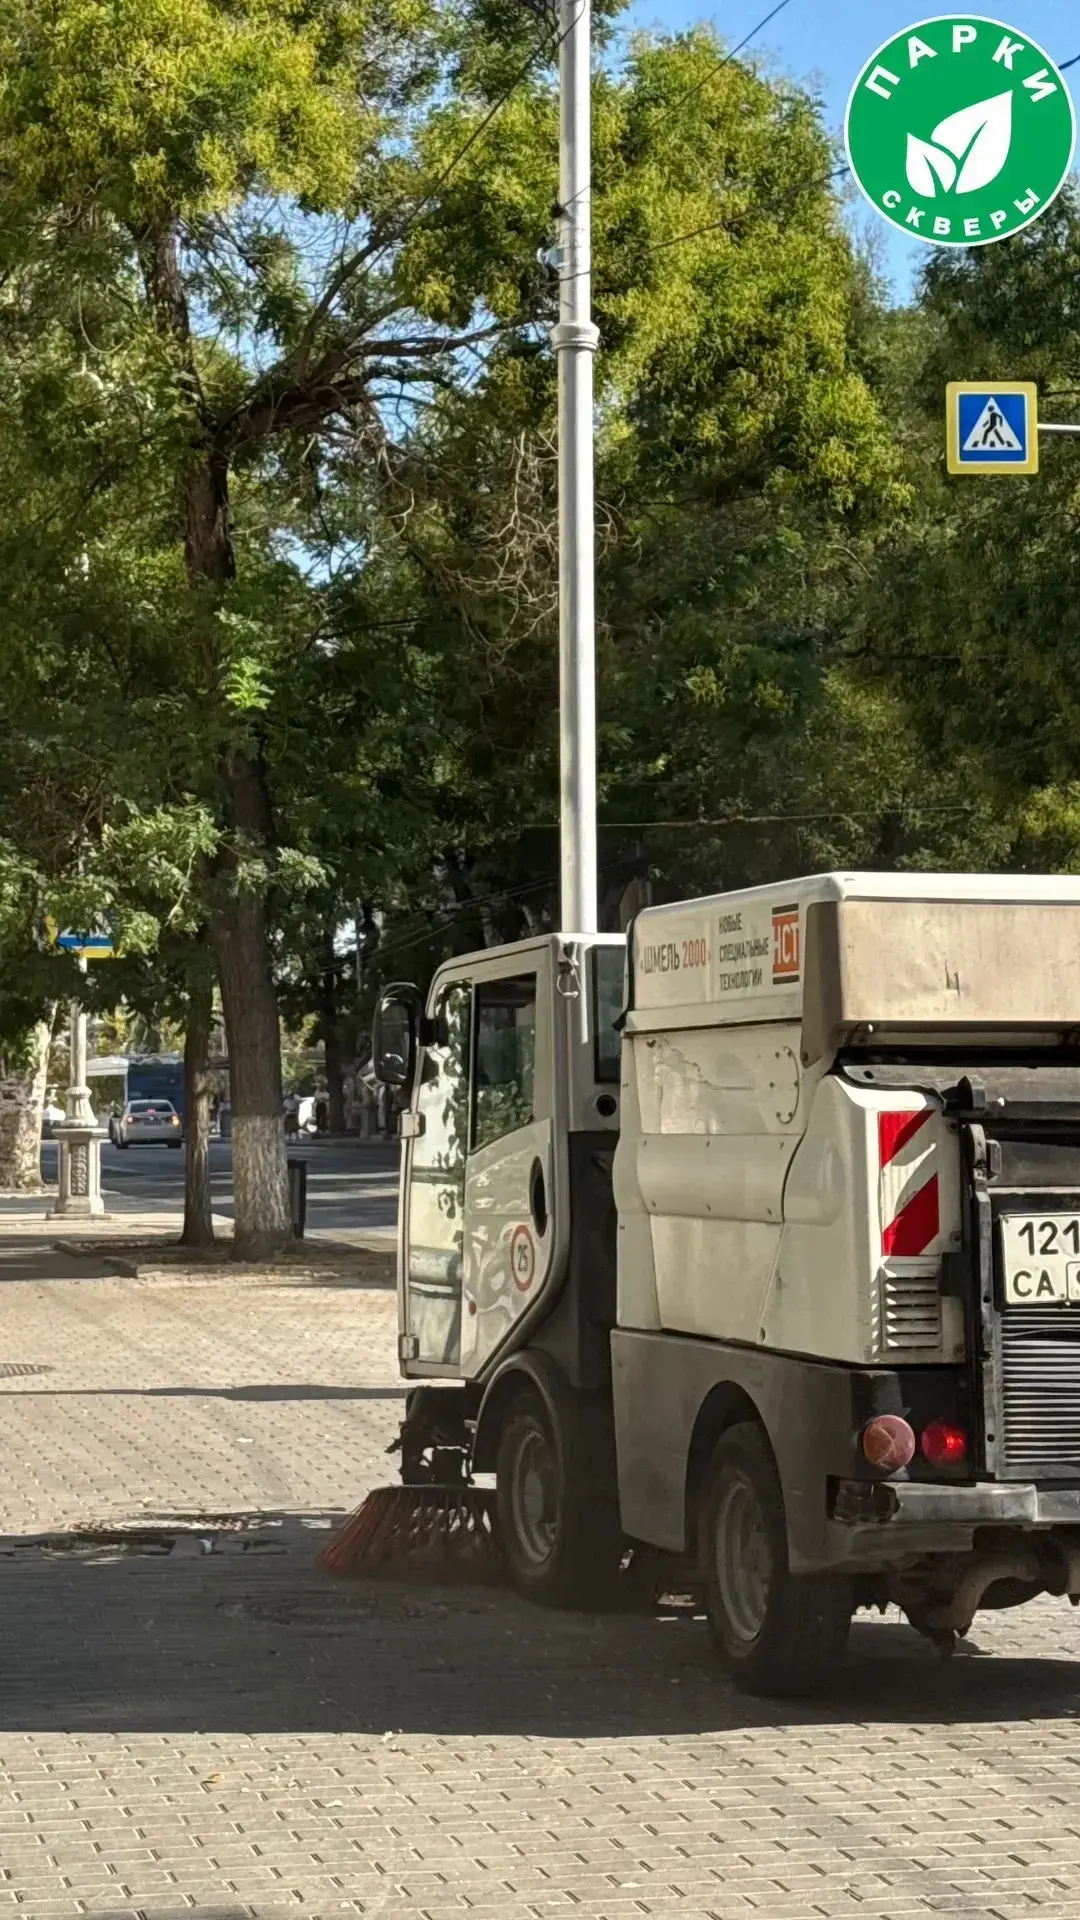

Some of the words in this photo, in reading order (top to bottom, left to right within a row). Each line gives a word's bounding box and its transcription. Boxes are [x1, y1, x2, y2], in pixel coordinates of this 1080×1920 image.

[719, 912, 743, 934] НОВЫЕ
[719, 936, 770, 964] СПЕЦИАЛЬНЫЕ
[720, 968, 763, 992] ТЕХНОЛОГИИ
[517, 1243, 529, 1273] 25
[1013, 1269, 1056, 1298] СА
